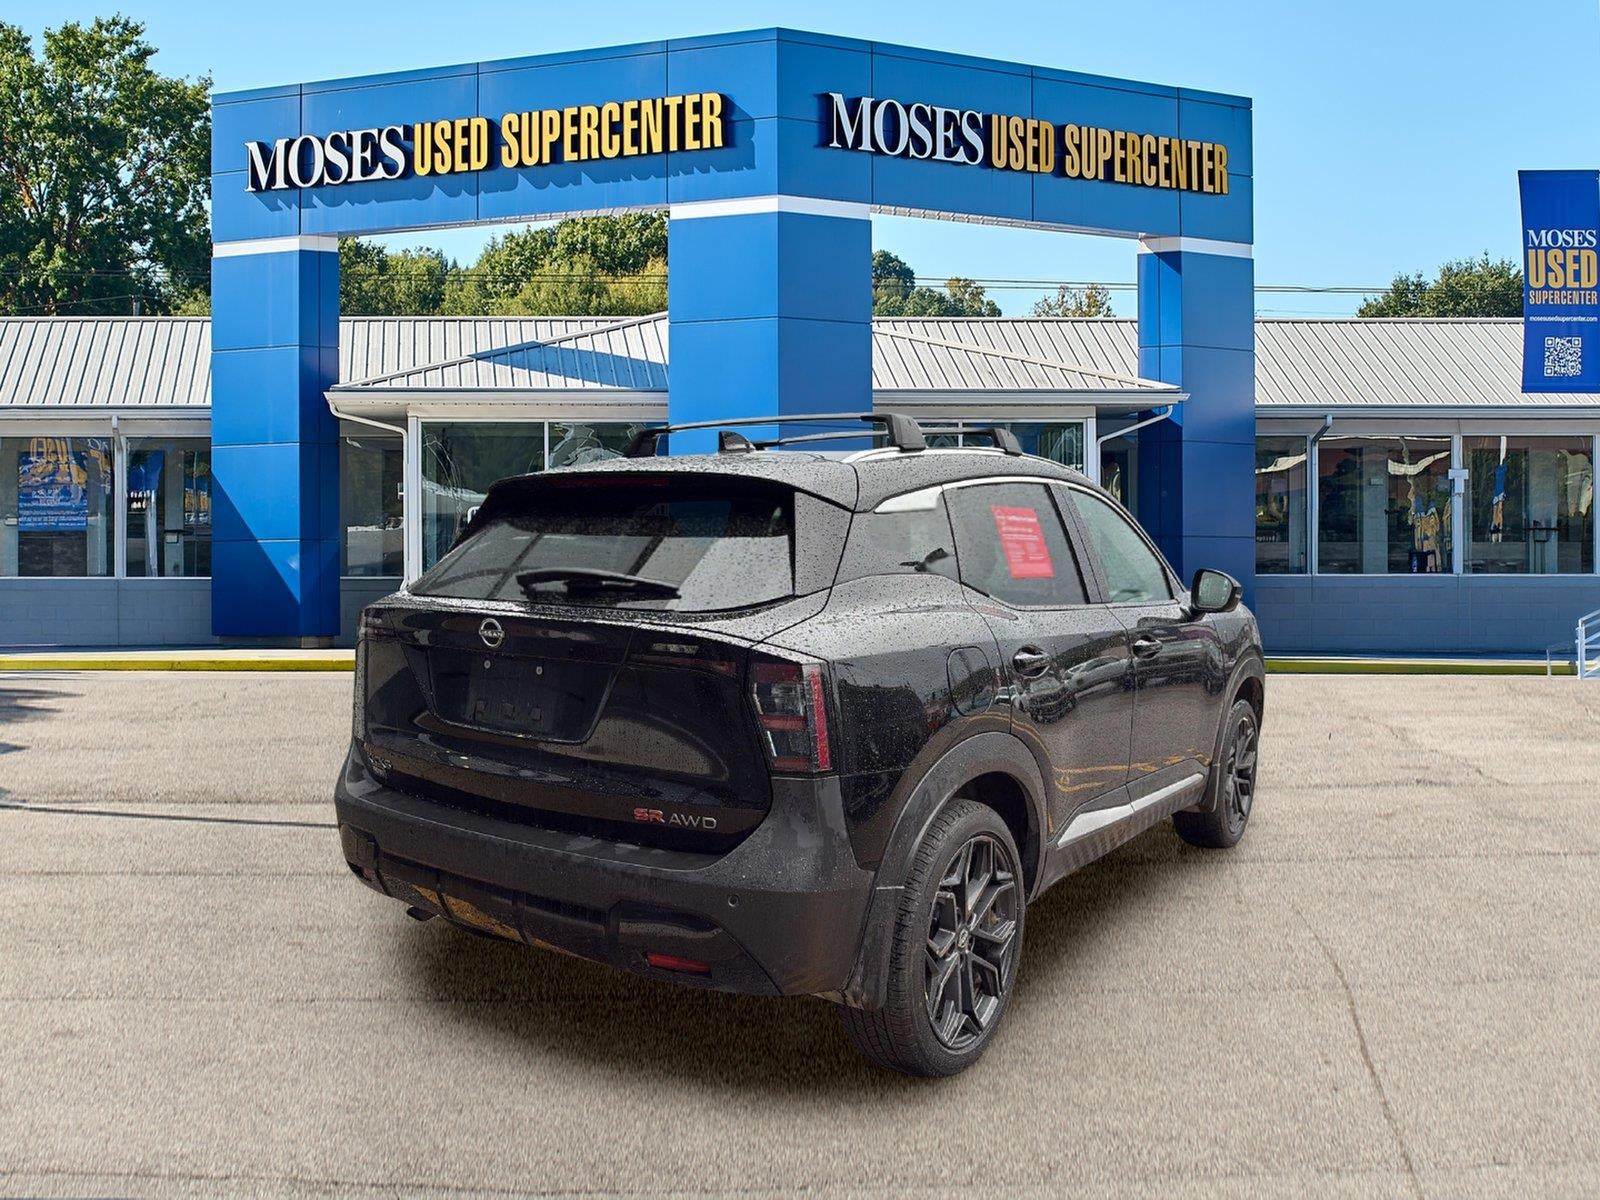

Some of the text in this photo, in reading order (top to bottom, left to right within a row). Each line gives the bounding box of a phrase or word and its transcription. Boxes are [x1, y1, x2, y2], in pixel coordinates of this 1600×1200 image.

[245, 92, 723, 191] MOSES USED SUPERCENTER
[829, 92, 1229, 194] MOSES USED SUPERCENTER
[1527, 229, 1597, 247] MOSES
[1528, 249, 1598, 288] USED
[1529, 291, 1598, 305] SUPERCENTER
[1529, 315, 1598, 323] mosesusedsupercenter.com
[633, 807, 717, 829] SR AWD
